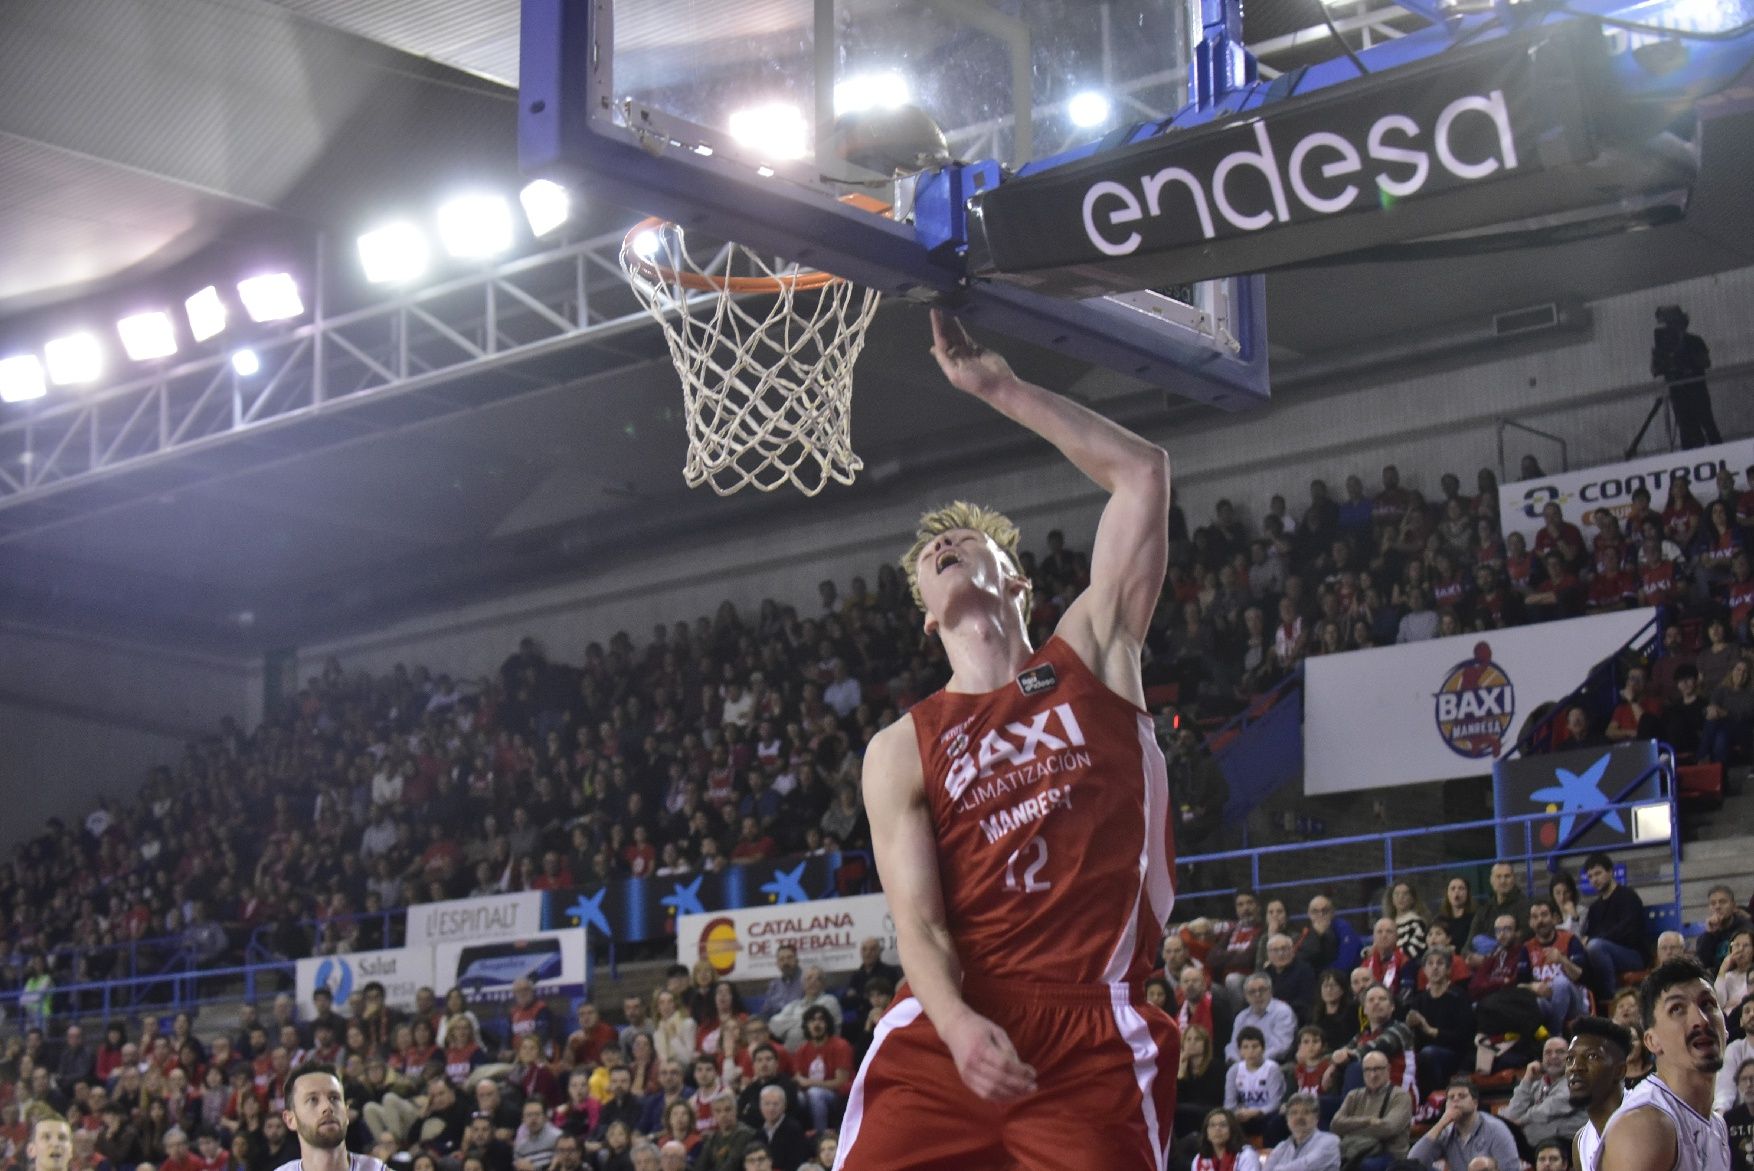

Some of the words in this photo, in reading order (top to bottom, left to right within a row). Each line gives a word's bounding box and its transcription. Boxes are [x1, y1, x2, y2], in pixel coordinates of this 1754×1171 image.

[1082, 90, 1518, 256] endesa
[1439, 685, 1512, 722] BAXI
[945, 702, 1086, 801] BAXI
[747, 911, 854, 937] CATALANA
[748, 938, 771, 956] DE
